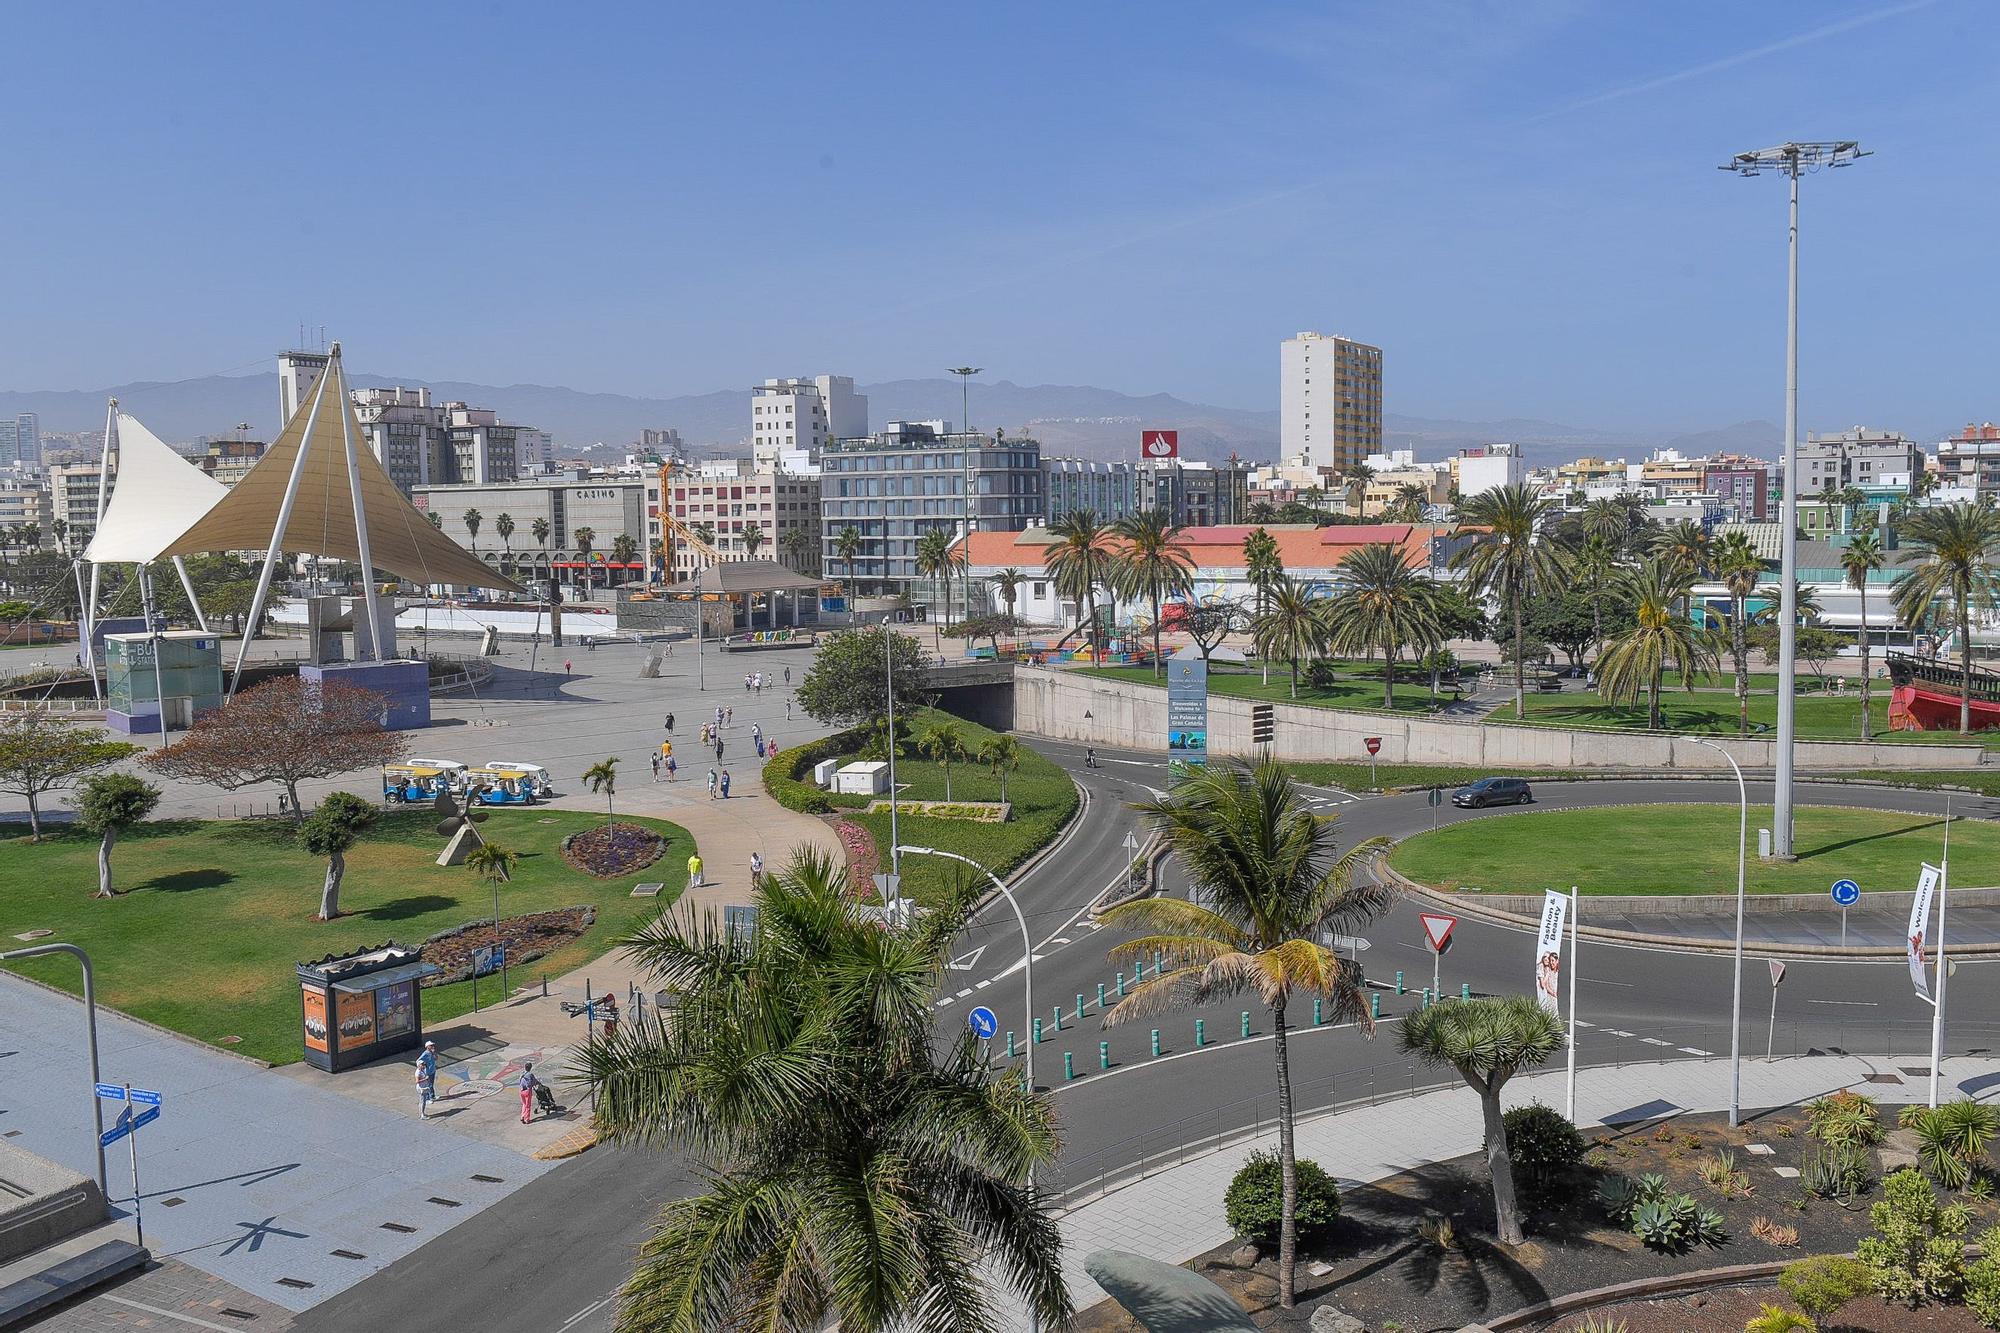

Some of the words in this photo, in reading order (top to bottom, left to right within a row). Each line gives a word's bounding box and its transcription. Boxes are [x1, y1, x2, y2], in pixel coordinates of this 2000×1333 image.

[577, 489, 615, 499] CASINO
[1543, 907, 1555, 946] Fashion
[1550, 898, 1556, 906] &
[1914, 876, 1930, 928] Welcome
[1550, 906, 1562, 941] Beauty
